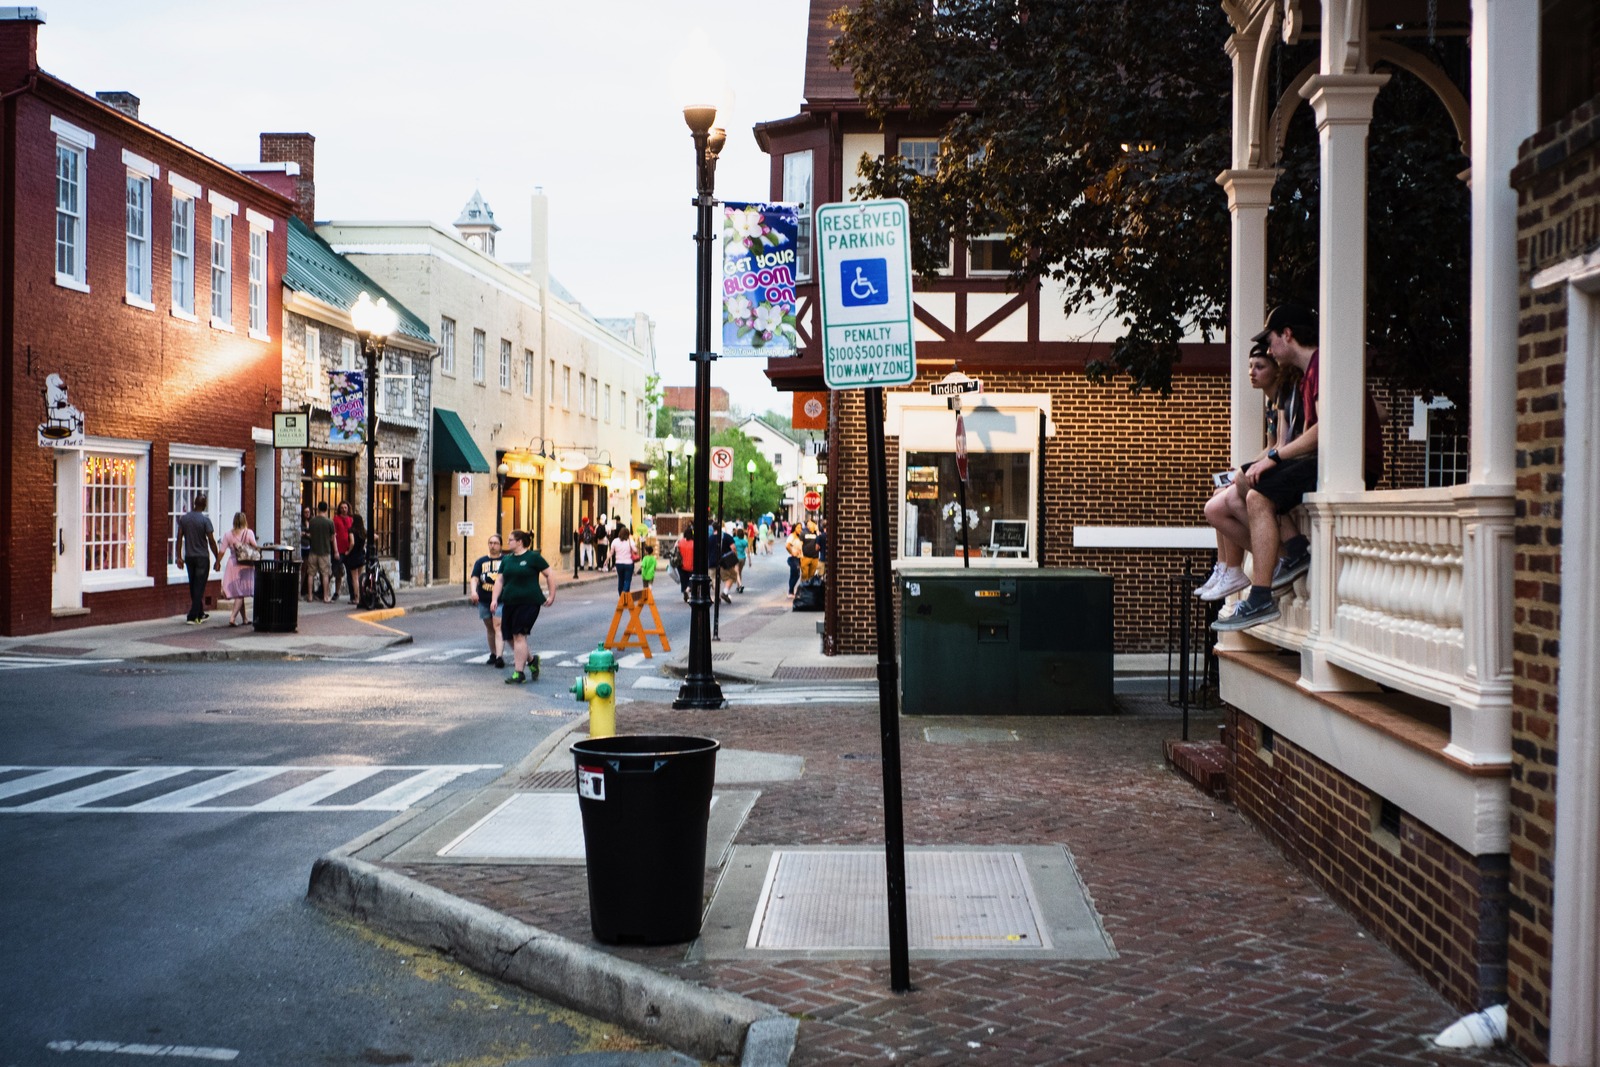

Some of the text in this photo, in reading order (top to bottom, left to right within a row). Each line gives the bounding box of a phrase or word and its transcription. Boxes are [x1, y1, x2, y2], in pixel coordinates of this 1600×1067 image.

[823, 211, 902, 232] RESERVED
[828, 231, 896, 250] PARKING
[723, 249, 795, 275] GET YOUR
[723, 266, 796, 297] BLOOM
[844, 327, 891, 343] PENALTY
[884, 343, 909, 358] FINE
[882, 360, 910, 375] ZONE
[345, 391, 363, 402] YOUR
[935, 383, 964, 395] Indian
[374, 457, 398, 469] ROKEN
[804, 496, 820, 505] STOP
